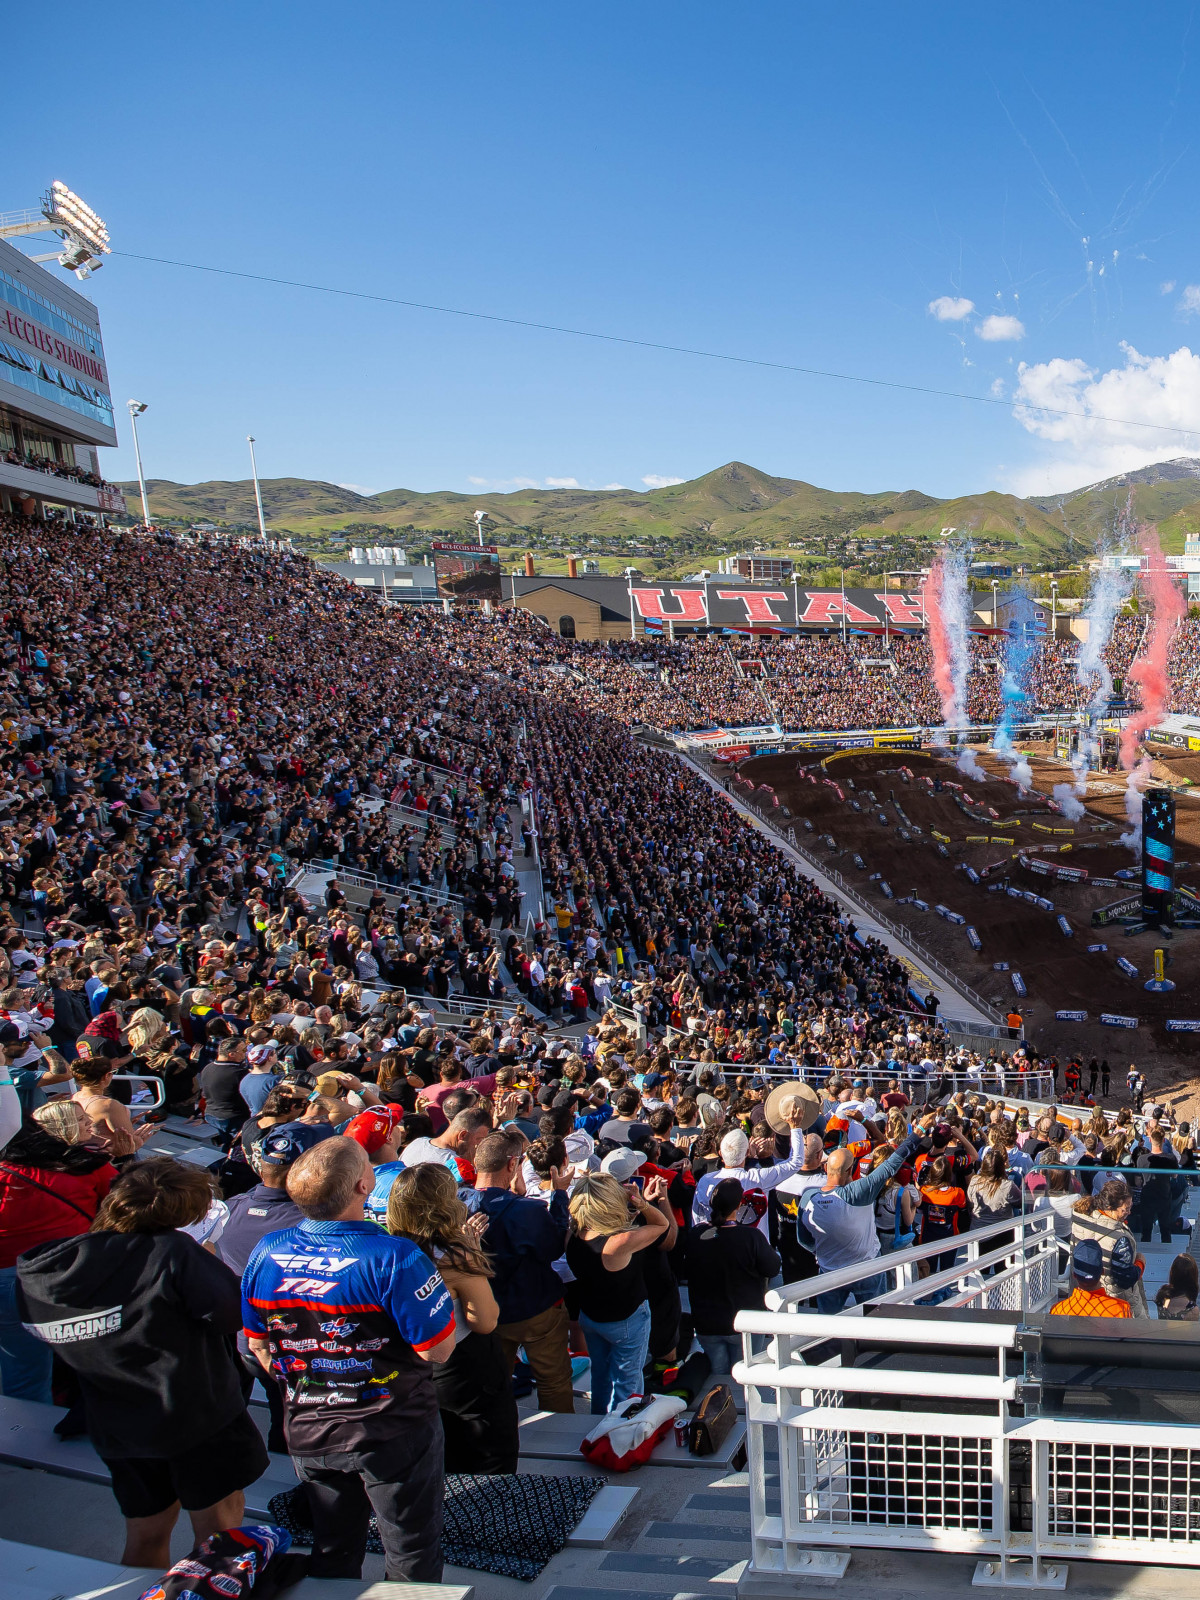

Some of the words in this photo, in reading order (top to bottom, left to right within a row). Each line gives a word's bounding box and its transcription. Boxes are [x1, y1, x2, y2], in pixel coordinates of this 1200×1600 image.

[0, 310, 54, 355] -ECCLES
[55, 338, 104, 383] STADIUM
[630, 587, 956, 624] UTAH
[1105, 709, 1136, 718] FINISH
[837, 739, 874, 747] FALKEN
[1107, 900, 1141, 918] MONSTER
[1101, 1018, 1135, 1026] FALKEN
[270, 1253, 360, 1273] FLY
[283, 1268, 334, 1277] RACING
[273, 1277, 341, 1295] TPJ
[78, 1332, 97, 1341] RACE
[98, 1326, 121, 1337] SHOP
